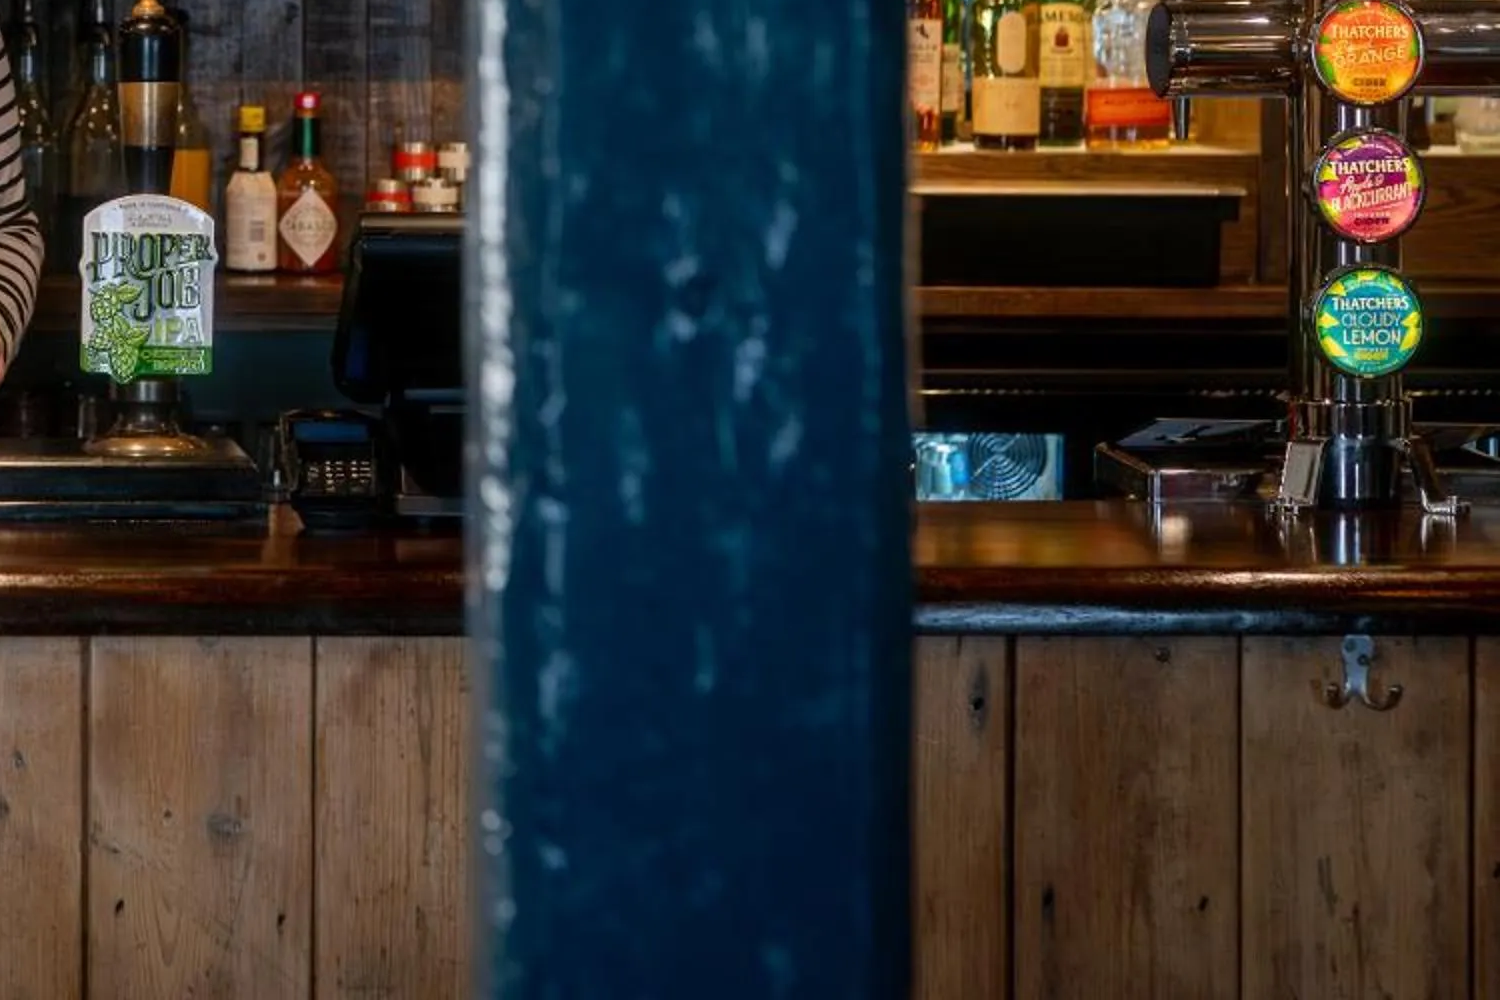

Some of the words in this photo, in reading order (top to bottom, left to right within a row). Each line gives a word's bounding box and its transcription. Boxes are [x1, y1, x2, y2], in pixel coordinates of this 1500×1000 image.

[1332, 24, 1409, 39] THATCHERS
[1332, 45, 1407, 69] ORANGE
[1330, 157, 1411, 175] THATCHERS
[86, 231, 214, 282] PROPER
[132, 265, 201, 323] JOB
[1332, 295, 1409, 311] THATCHERS
[1341, 312, 1401, 328] CLOUDY
[154, 316, 203, 345] IPA
[1343, 329, 1401, 345] LEMON
